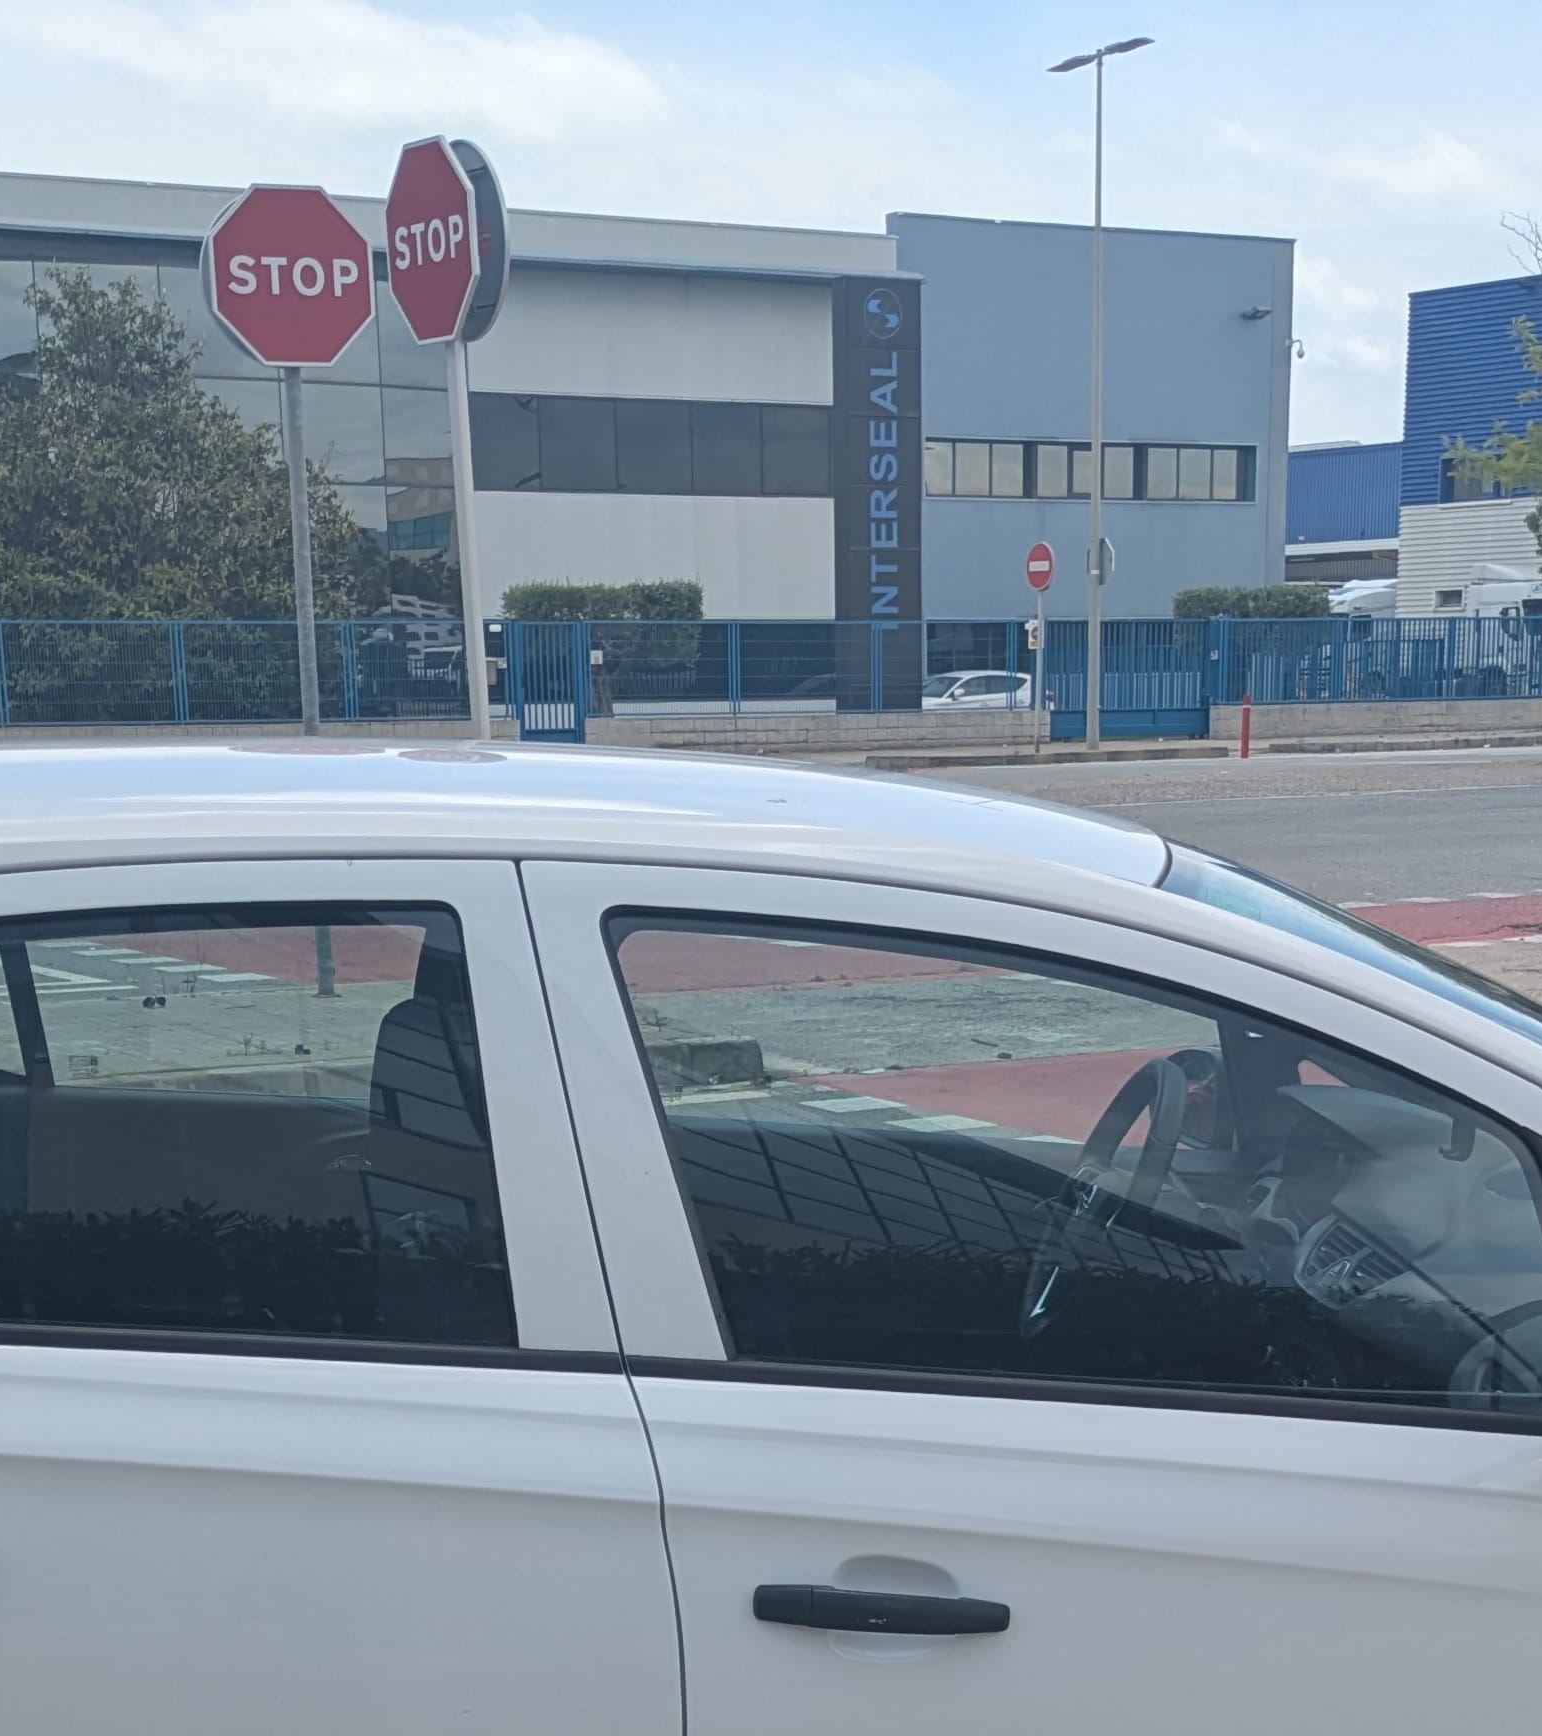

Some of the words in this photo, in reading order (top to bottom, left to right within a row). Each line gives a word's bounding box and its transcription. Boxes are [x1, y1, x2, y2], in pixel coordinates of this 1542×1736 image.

[395, 214, 464, 270] STOP
[227, 255, 359, 297] STOP
[869, 352, 900, 630] INTERSEAL
